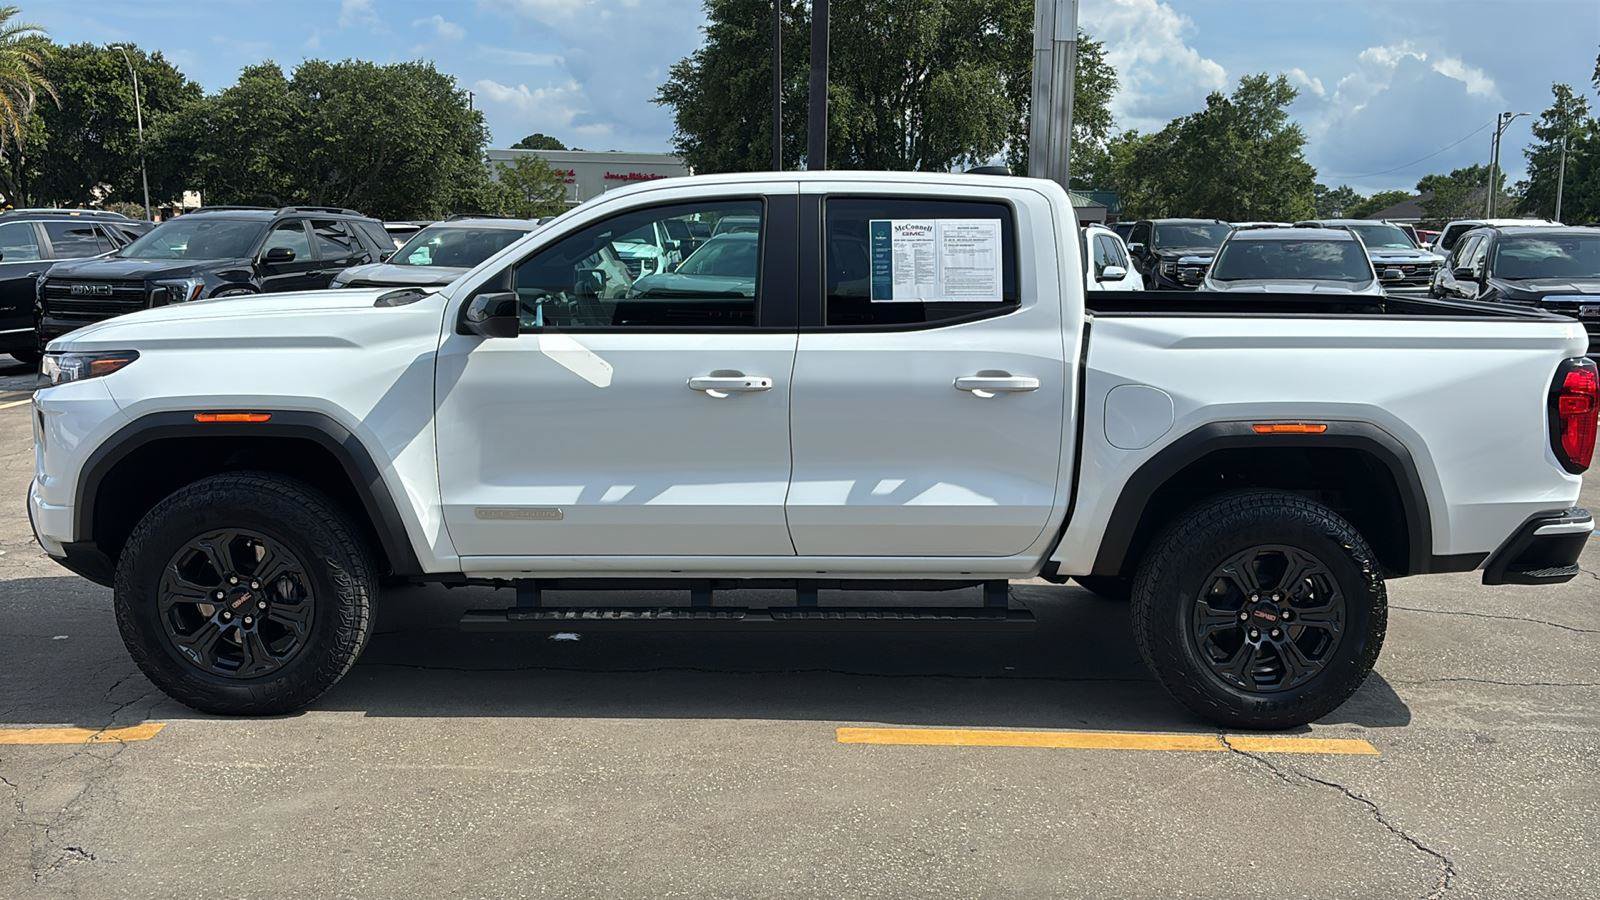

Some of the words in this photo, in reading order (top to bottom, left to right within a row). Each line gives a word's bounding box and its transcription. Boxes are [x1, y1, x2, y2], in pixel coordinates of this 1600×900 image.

[894, 223, 932, 232] McConnell
[71, 284, 110, 296] GMC
[232, 592, 252, 609] GMC
[1253, 610, 1277, 622] GMC
